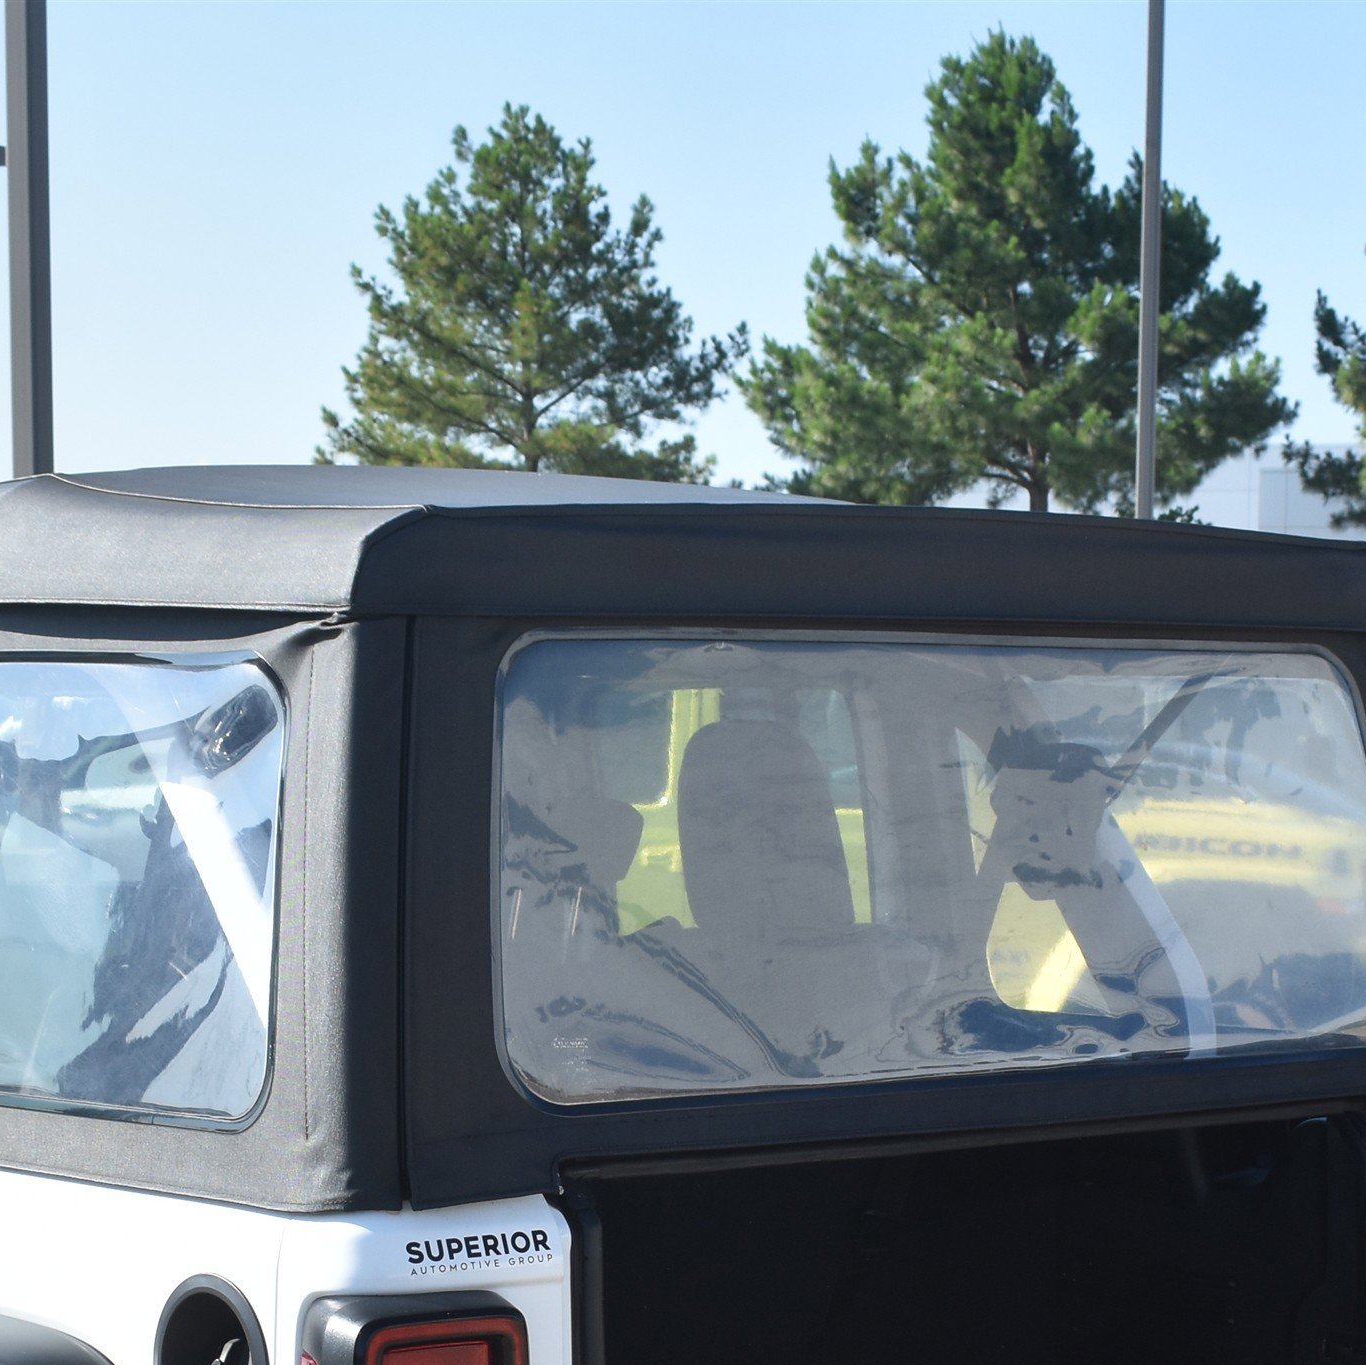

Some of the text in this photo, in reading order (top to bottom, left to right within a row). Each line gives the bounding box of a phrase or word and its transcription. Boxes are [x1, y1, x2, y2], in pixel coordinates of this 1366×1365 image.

[1133, 834, 1303, 860] BICON
[405, 1229, 551, 1264] SUPERIOR
[410, 1253, 553, 1276] AUTOMOTIVE GROUP
